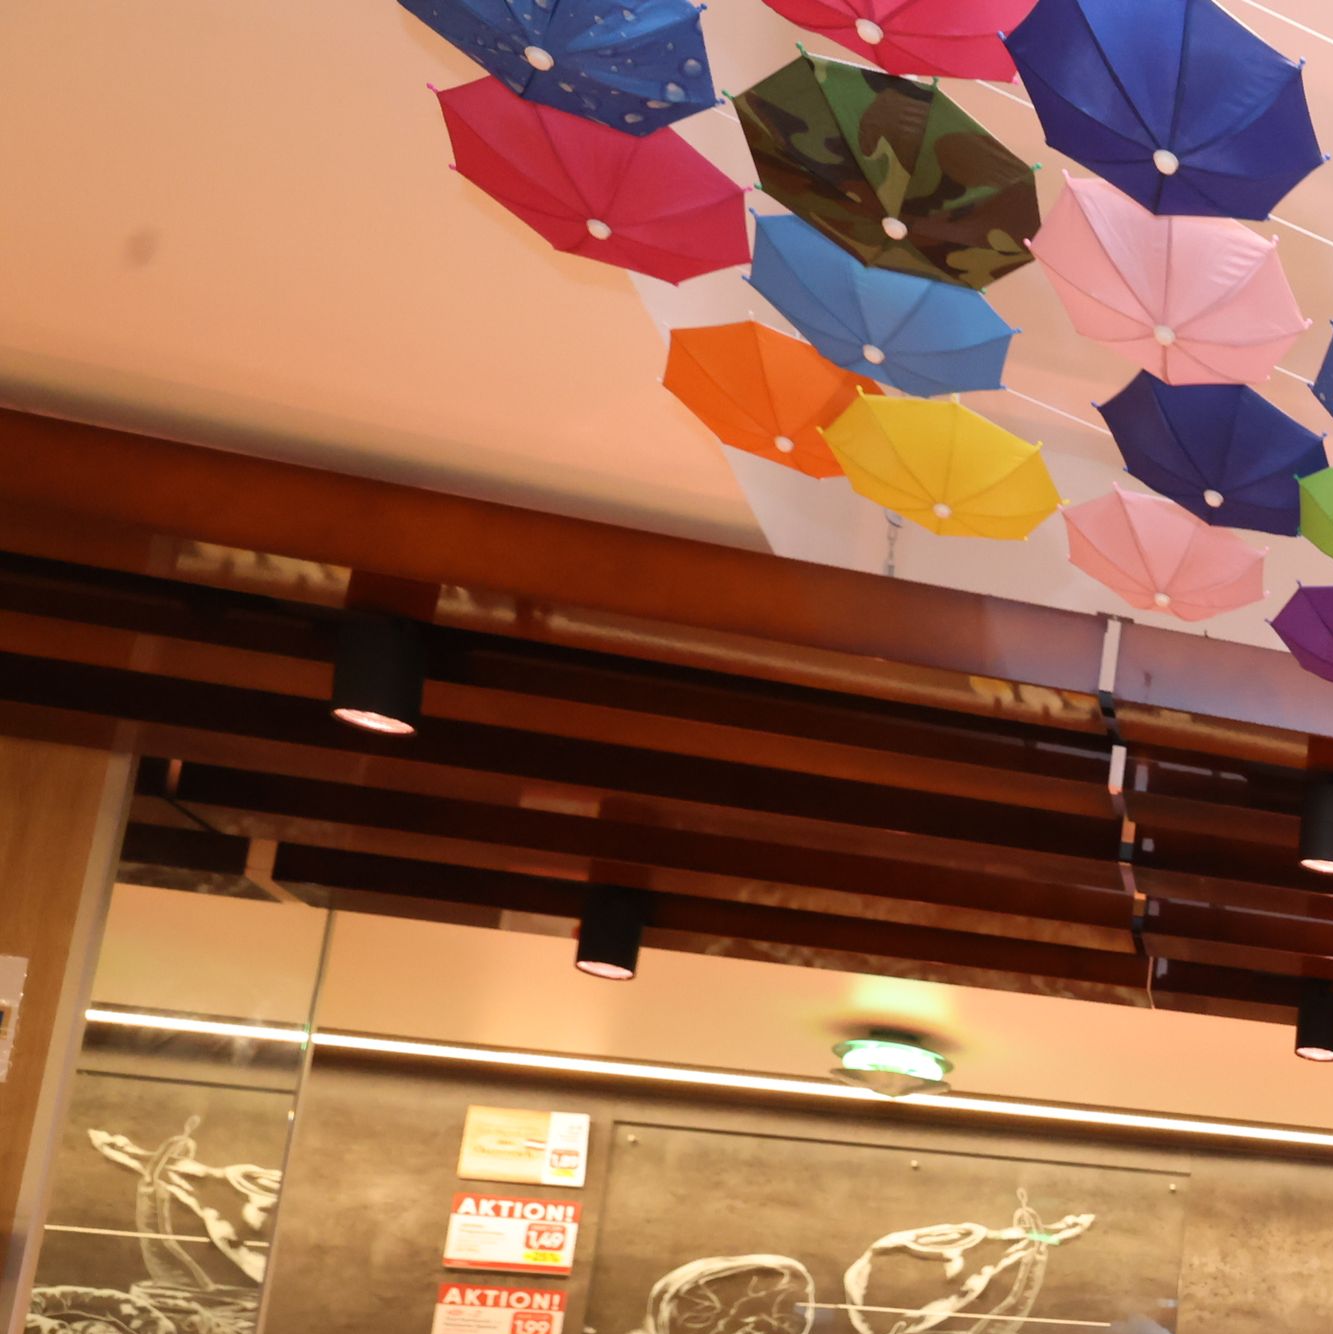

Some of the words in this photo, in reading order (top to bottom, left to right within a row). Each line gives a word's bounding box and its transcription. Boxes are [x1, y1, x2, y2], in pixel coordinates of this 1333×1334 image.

[456, 1196, 576, 1222] AKTION!
[527, 1230, 565, 1249] 1,49
[442, 1286, 562, 1311] AKTION!
